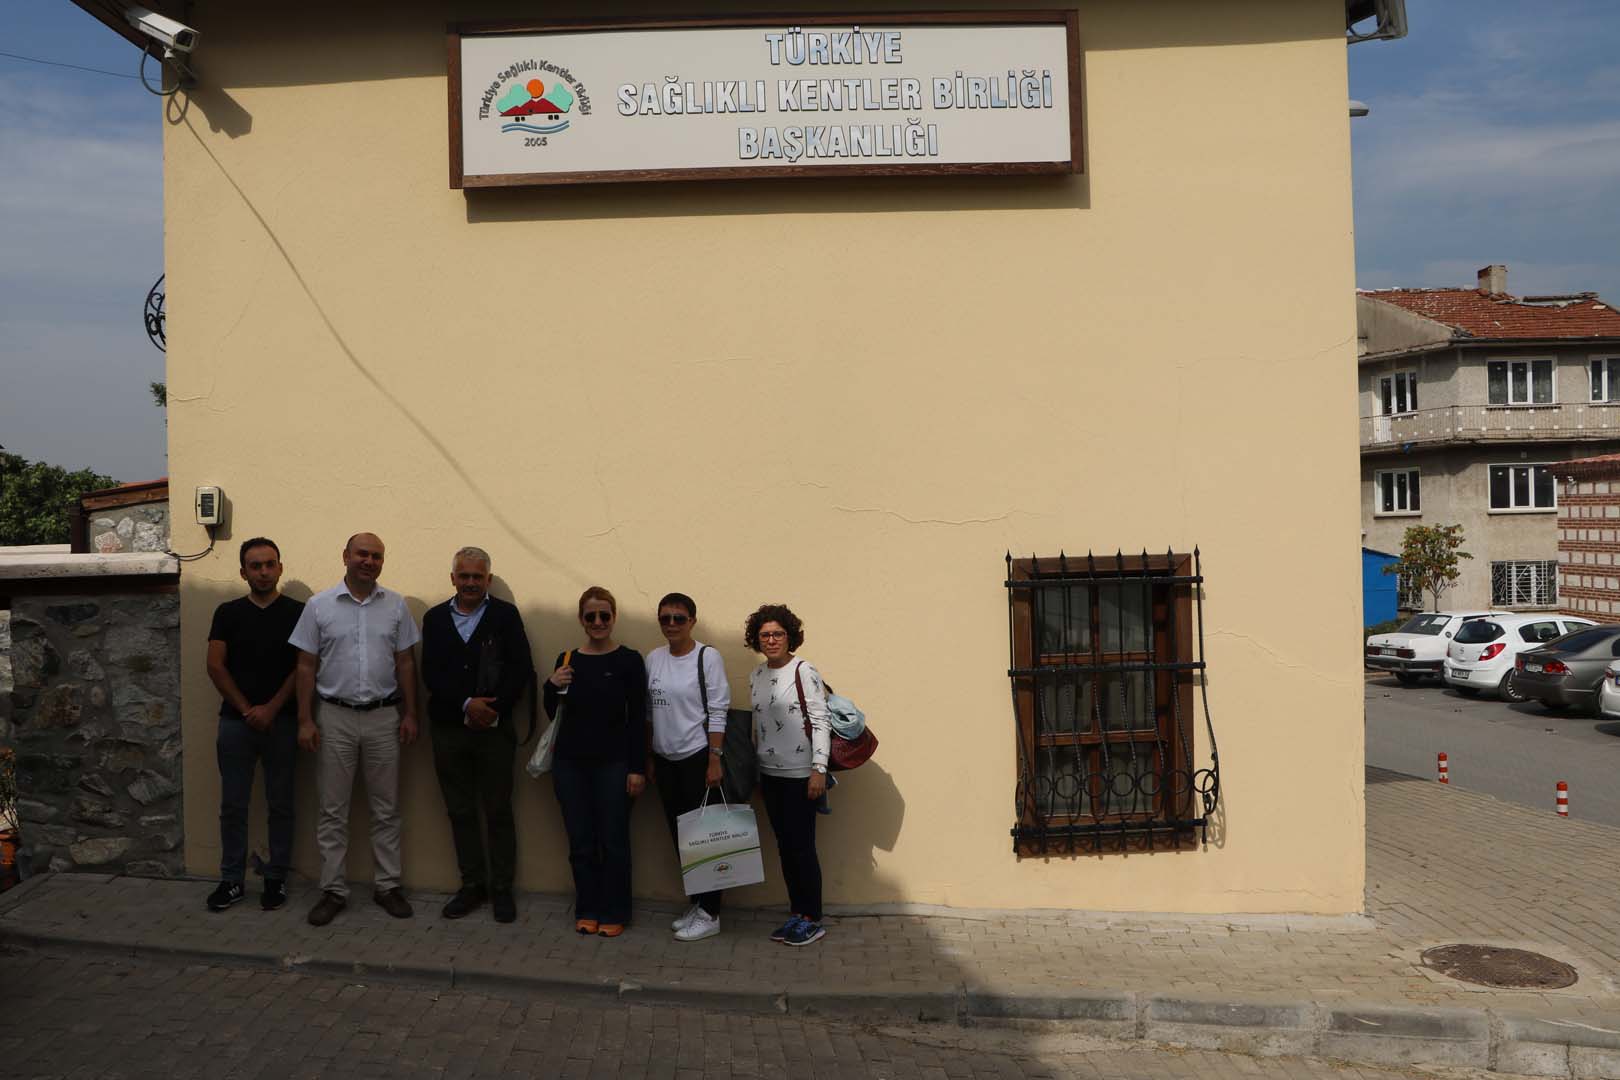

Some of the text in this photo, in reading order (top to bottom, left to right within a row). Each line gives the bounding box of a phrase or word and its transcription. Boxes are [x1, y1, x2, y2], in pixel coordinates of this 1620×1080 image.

[765, 25, 903, 65] TÜRKİYE
[479, 80, 502, 121] Türkiye
[497, 59, 539, 83] Sağlıklı
[539, 60, 577, 84] Kentler
[617, 69, 1053, 116] SAĞLIKLI KENTLER BİRLİĞİ
[524, 137, 548, 147] 2005
[738, 117, 939, 163] BAŞKANLIĞI
